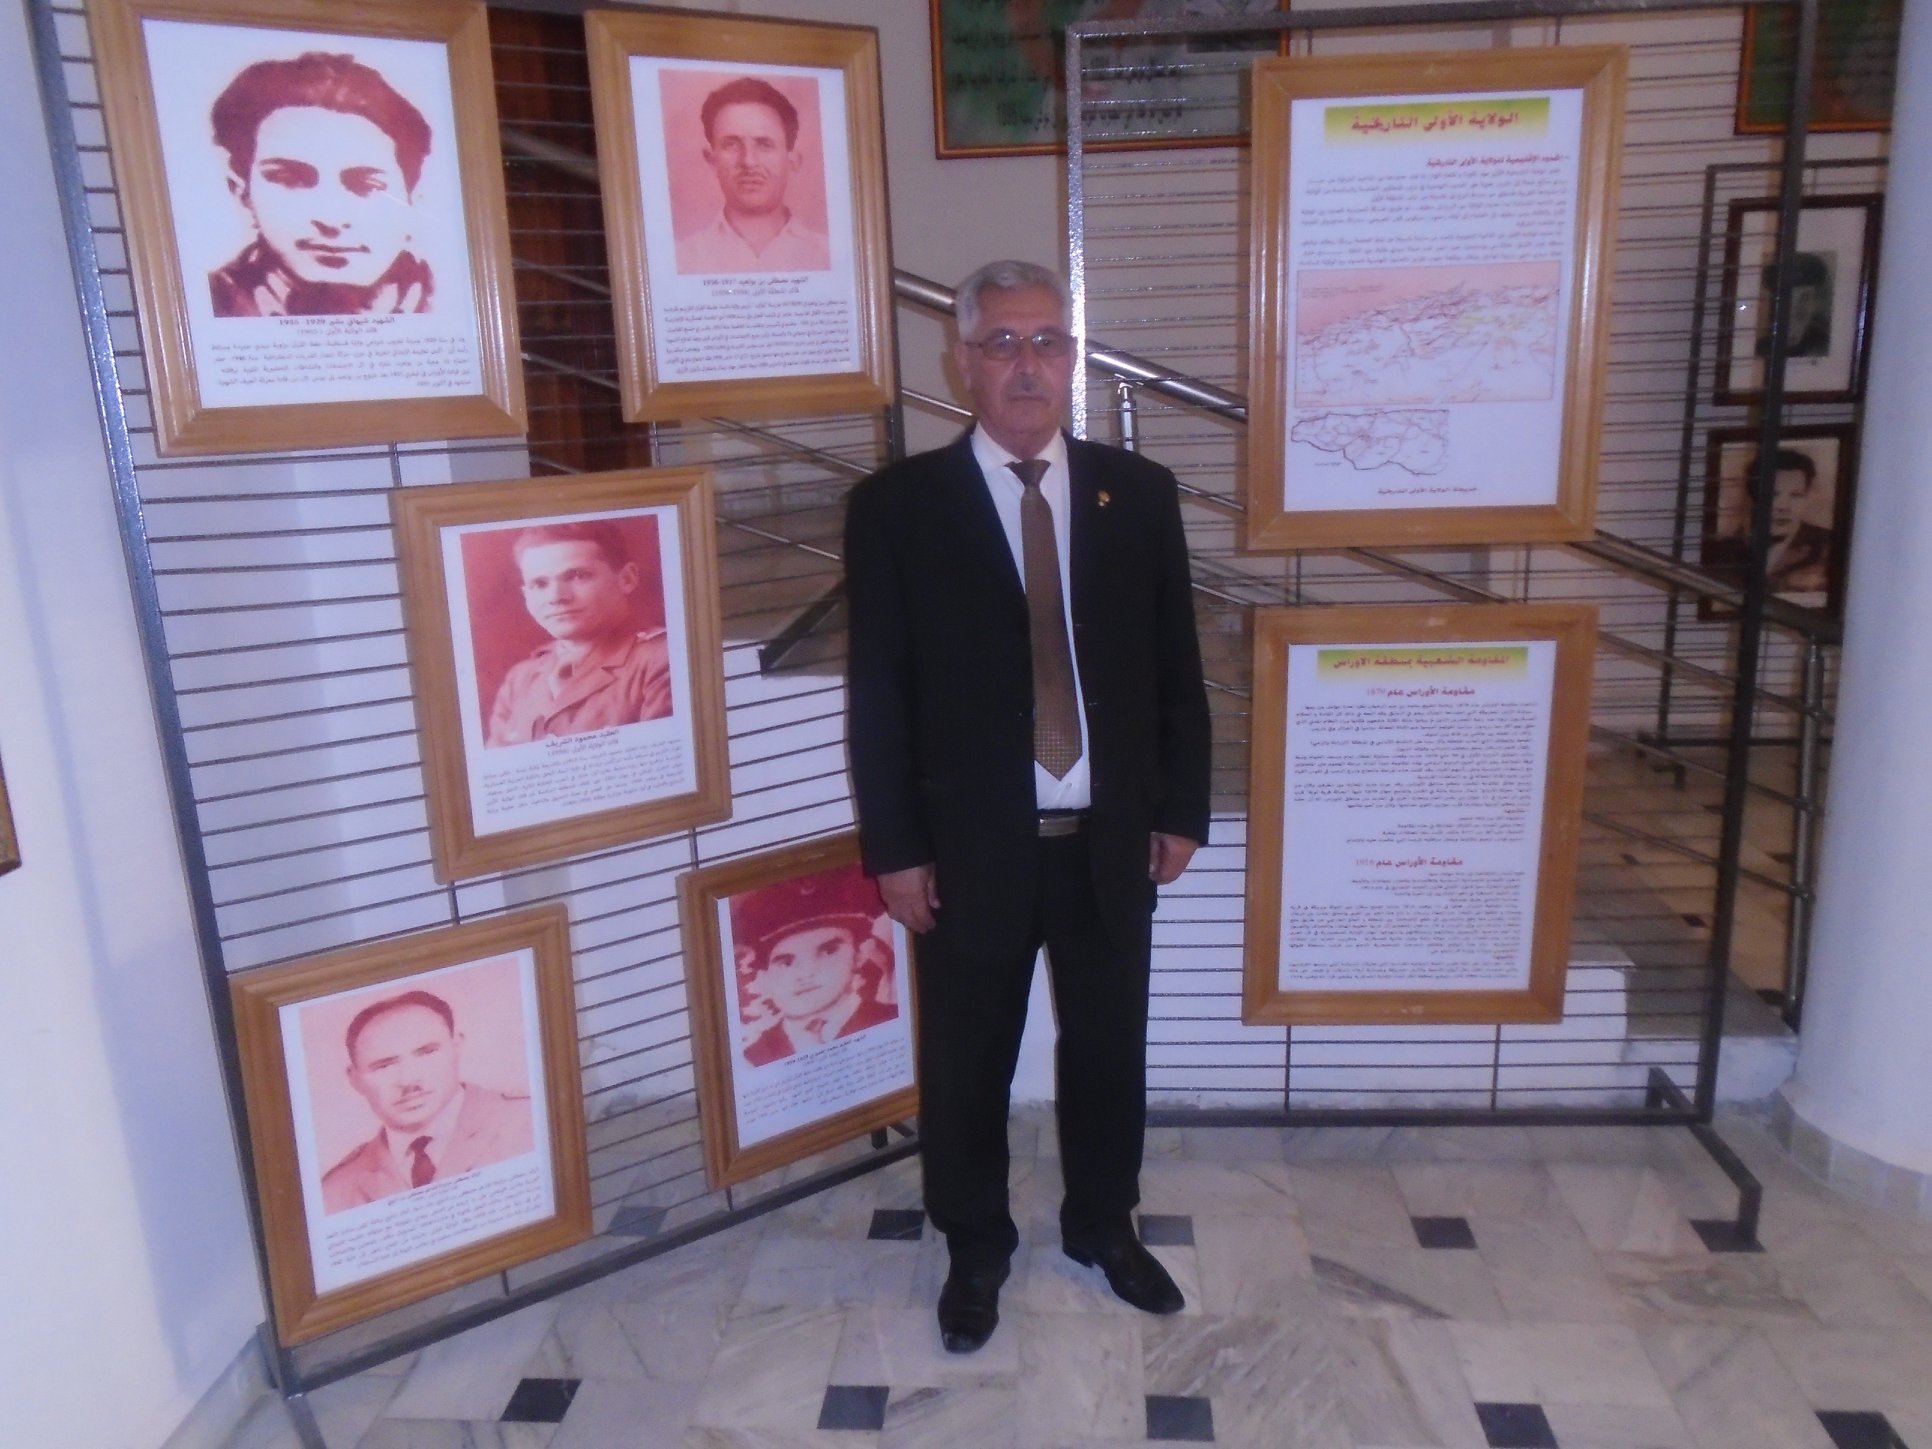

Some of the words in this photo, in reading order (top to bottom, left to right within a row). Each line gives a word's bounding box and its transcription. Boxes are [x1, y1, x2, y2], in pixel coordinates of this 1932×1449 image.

[1423, 109, 1463, 132] الأولى
[1468, 110, 1519, 129] الولاية
[1333, 655, 1371, 670] الأوراس
[1416, 654, 1464, 668] الشعبية
[1468, 653, 1510, 667] المقاومة
[1406, 685, 1439, 698] الأوراس
[1441, 686, 1476, 697] مقاومة
[1394, 856, 1427, 869] الأوراس
[1429, 856, 1463, 868] مقاومة
